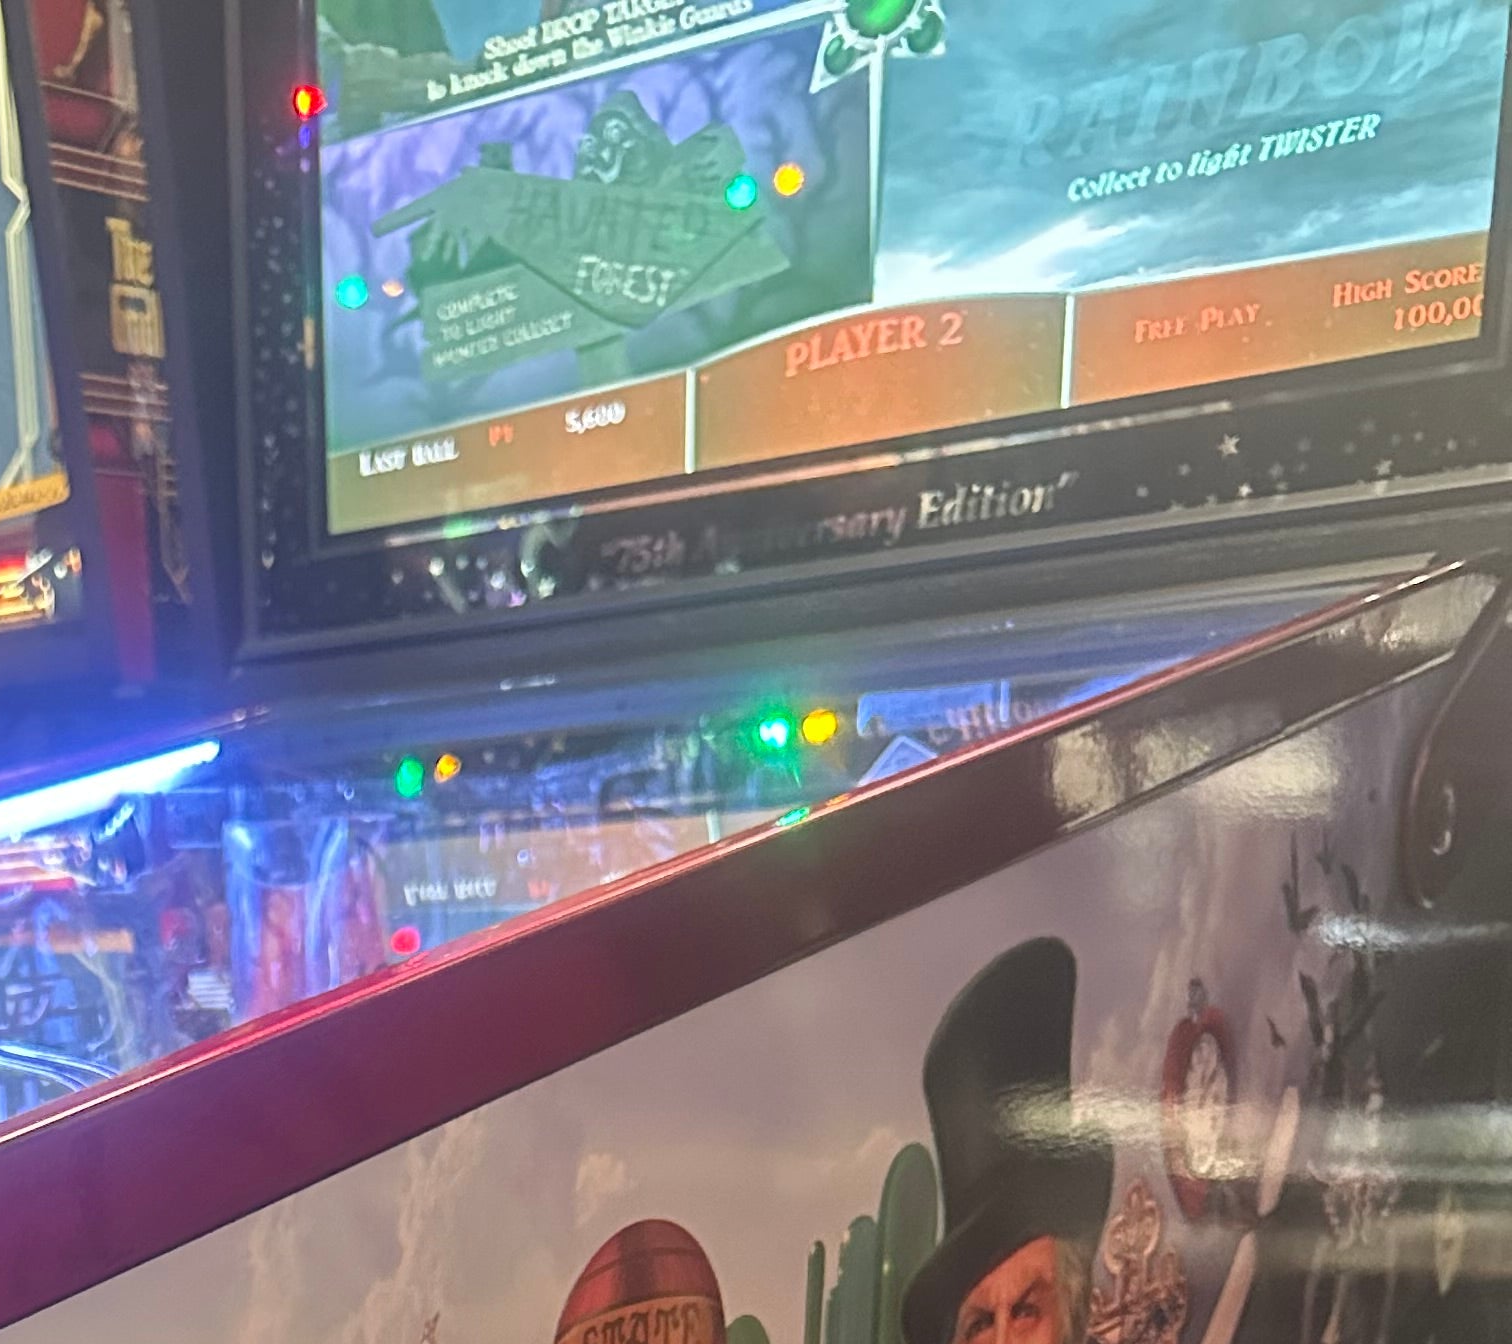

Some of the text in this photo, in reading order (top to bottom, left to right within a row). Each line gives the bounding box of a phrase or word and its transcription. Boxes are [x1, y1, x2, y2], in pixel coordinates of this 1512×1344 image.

[541, 9, 600, 44] DROP
[511, 53, 568, 77] down
[1006, 2, 1476, 166] RAINBOW
[1067, 112, 1382, 202] Collect to light TWISTER
[1332, 278, 1394, 308] HIGH
[1133, 302, 1261, 344] FREE PLAY
[784, 311, 966, 378] PLAYER 2
